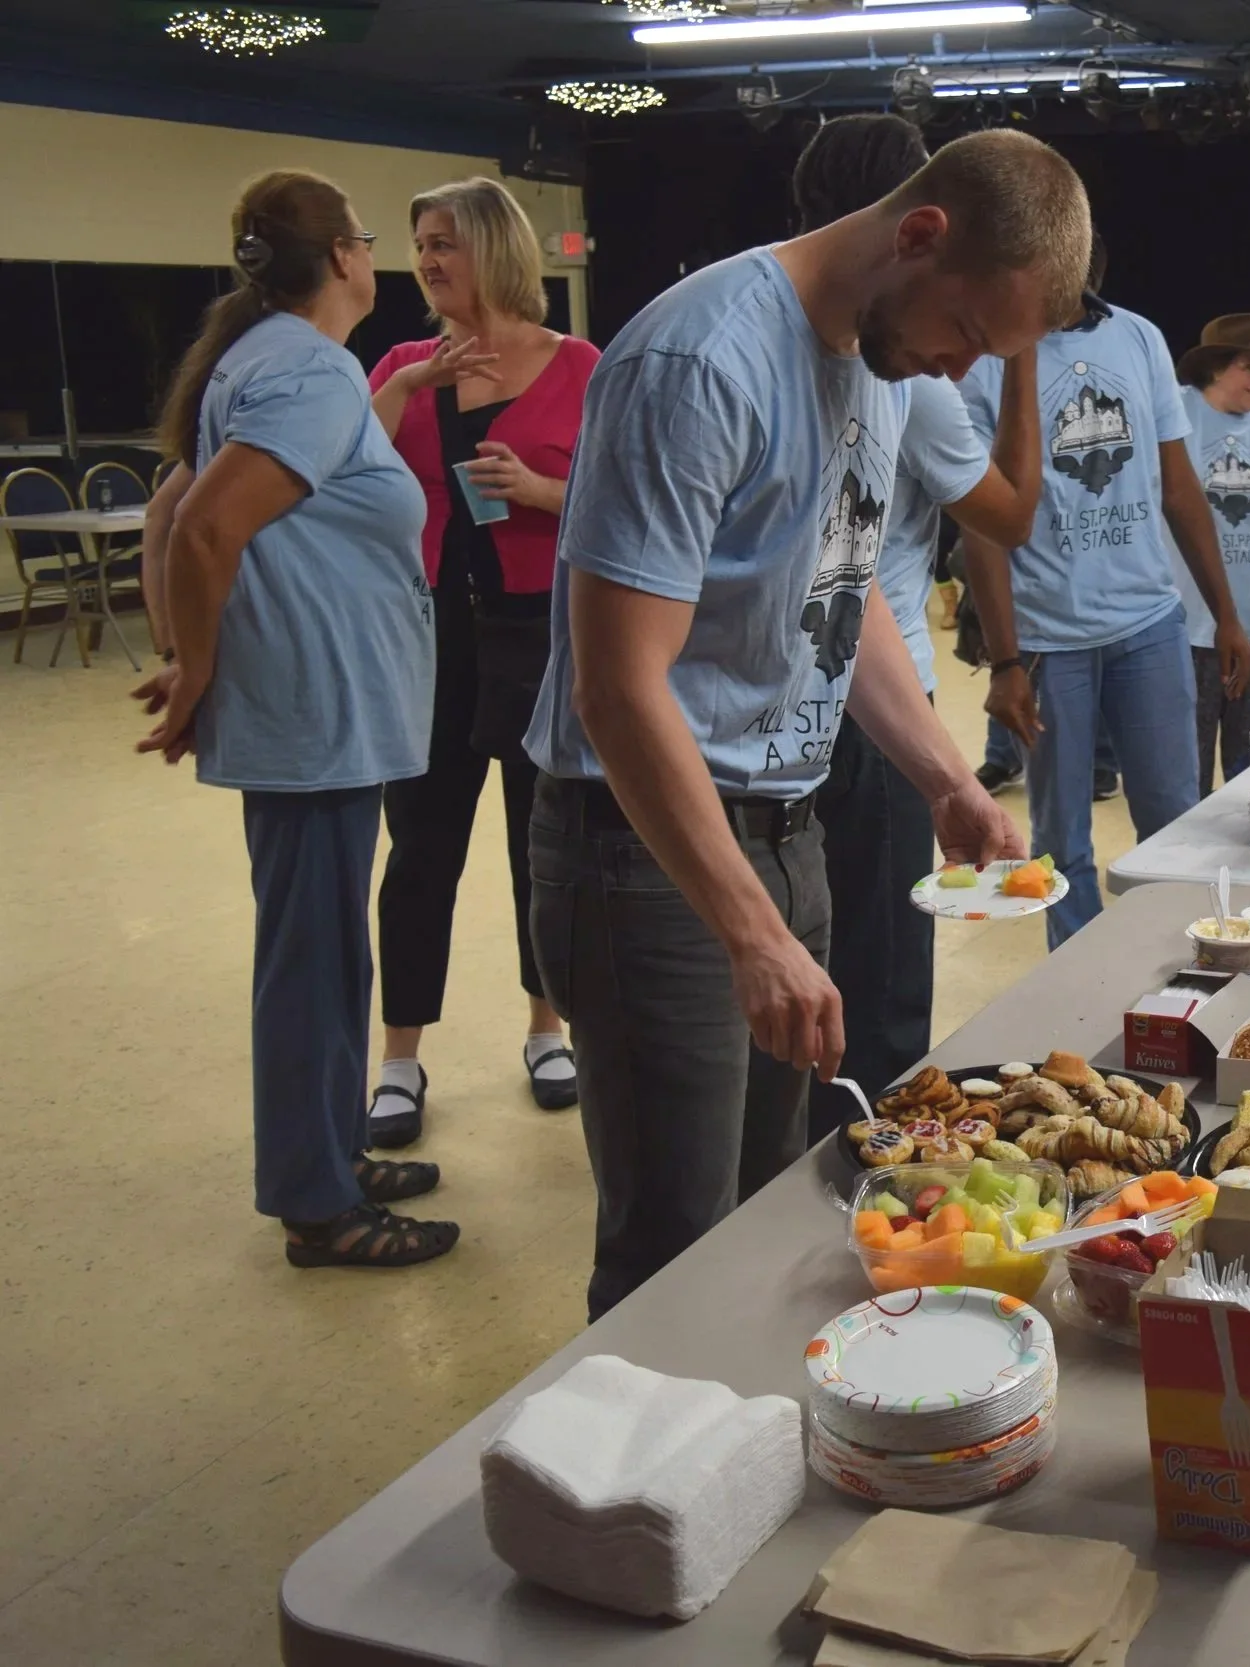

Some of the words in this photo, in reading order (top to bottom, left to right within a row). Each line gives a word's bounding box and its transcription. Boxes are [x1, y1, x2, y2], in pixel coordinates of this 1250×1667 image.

[1050, 512, 1074, 531] ALL
[1060, 535, 1073, 553] A
[1082, 525, 1133, 551] STAGE
[743, 705, 785, 734] ALL
[763, 741, 784, 772] A
[1135, 1051, 1177, 1070] Knives
[1163, 1446, 1244, 1506] Daily
